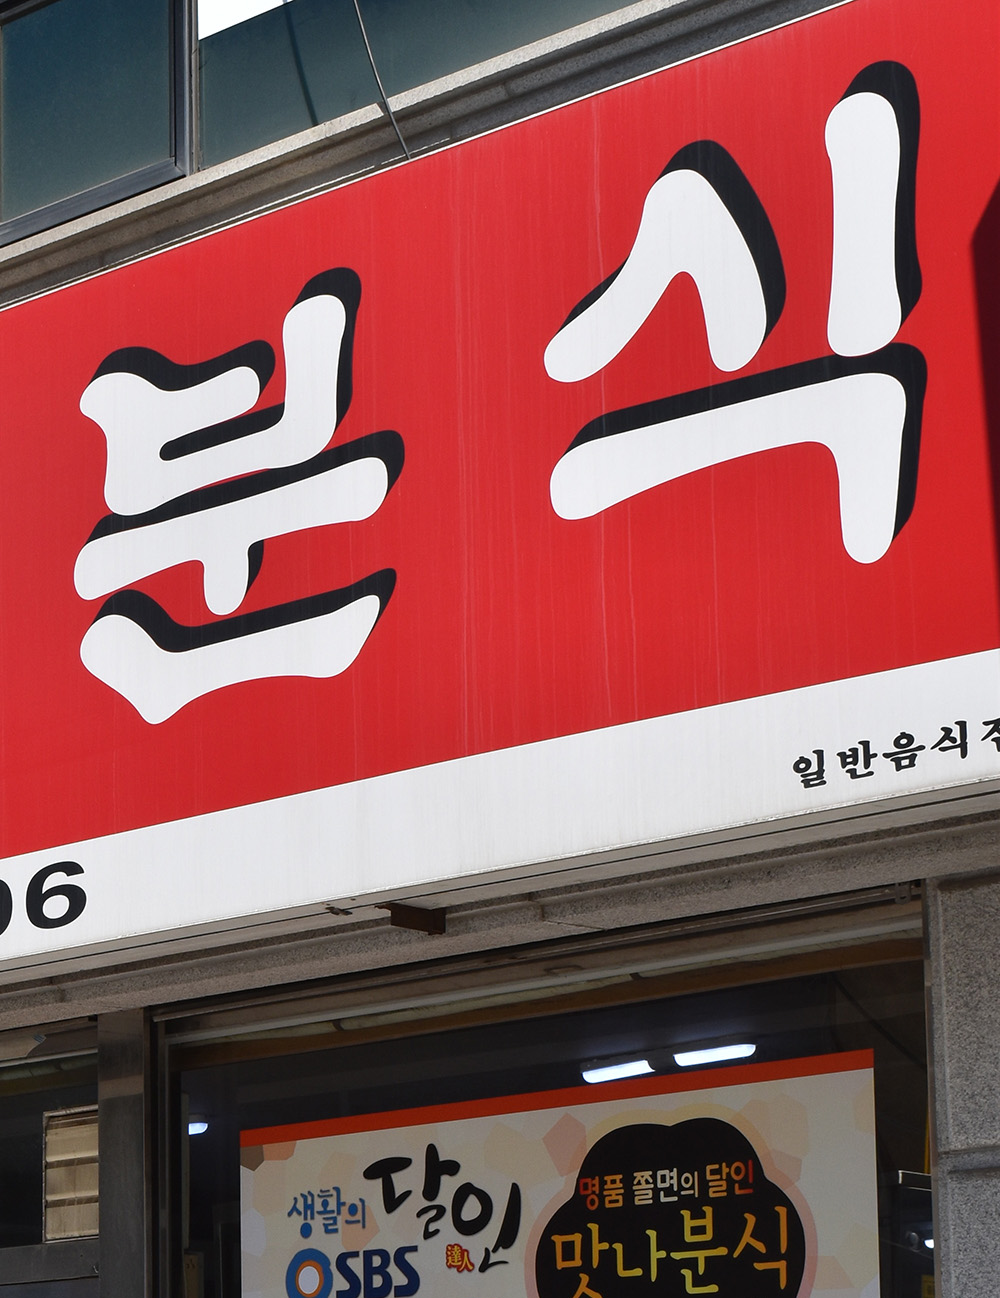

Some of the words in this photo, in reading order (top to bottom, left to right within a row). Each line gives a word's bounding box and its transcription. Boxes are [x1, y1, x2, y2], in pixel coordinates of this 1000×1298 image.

[287, 1186, 366, 1238] 생활의
[363, 1143, 521, 1273] 달인
[579, 1173, 624, 1211] 명품
[632, 1168, 699, 1206] 쫄면의
[705, 1160, 754, 1198] 달인
[445, 1243, 475, 1273] 達人
